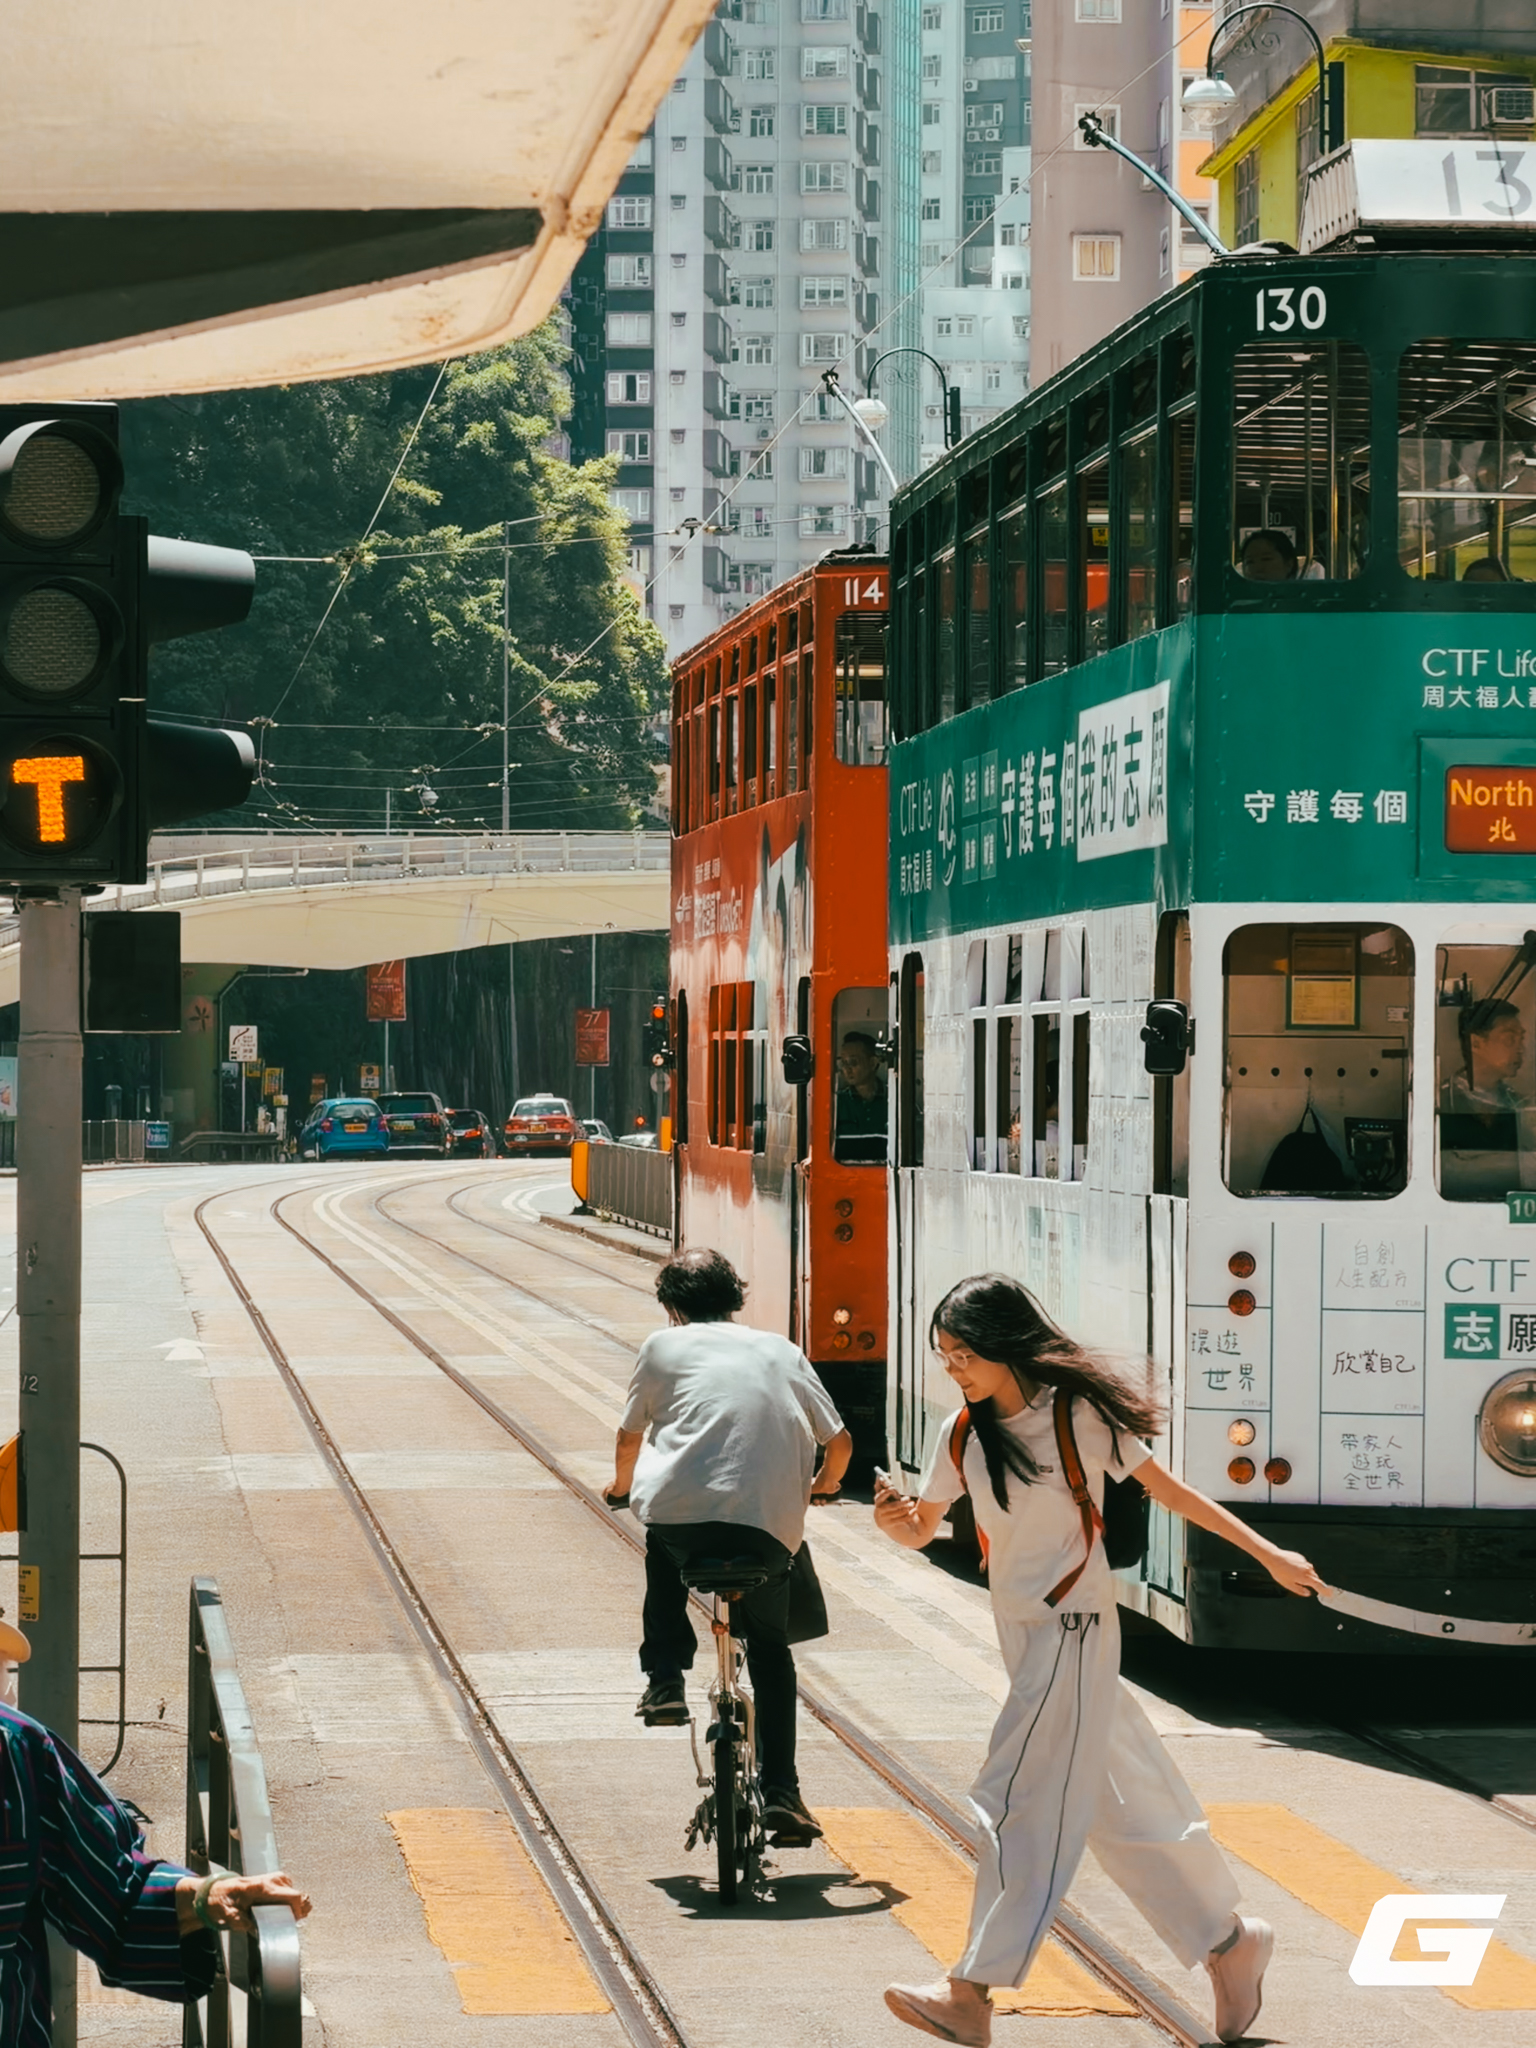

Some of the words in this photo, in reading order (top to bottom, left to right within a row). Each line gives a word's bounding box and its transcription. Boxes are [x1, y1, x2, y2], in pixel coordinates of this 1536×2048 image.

[1256, 285, 1327, 332] 130
[844, 576, 885, 606] 114
[1421, 648, 1490, 677] CTF
[12, 755, 85, 843] T
[1243, 789, 1408, 824] 守護每個
[1450, 778, 1533, 807] North
[1488, 816, 1517, 843] 北
[1353, 1238, 1396, 1266] 自創
[1335, 1267, 1408, 1289] 人生配方
[1445, 1257, 1530, 1293] CTF
[1190, 1328, 1241, 1357] 環遊
[1331, 1349, 1416, 1377] 欣賞自己
[1201, 1363, 1256, 1393] 世界
[1340, 1432, 1403, 1452] 帶家人
[1343, 1471, 1406, 1492] 全世界
